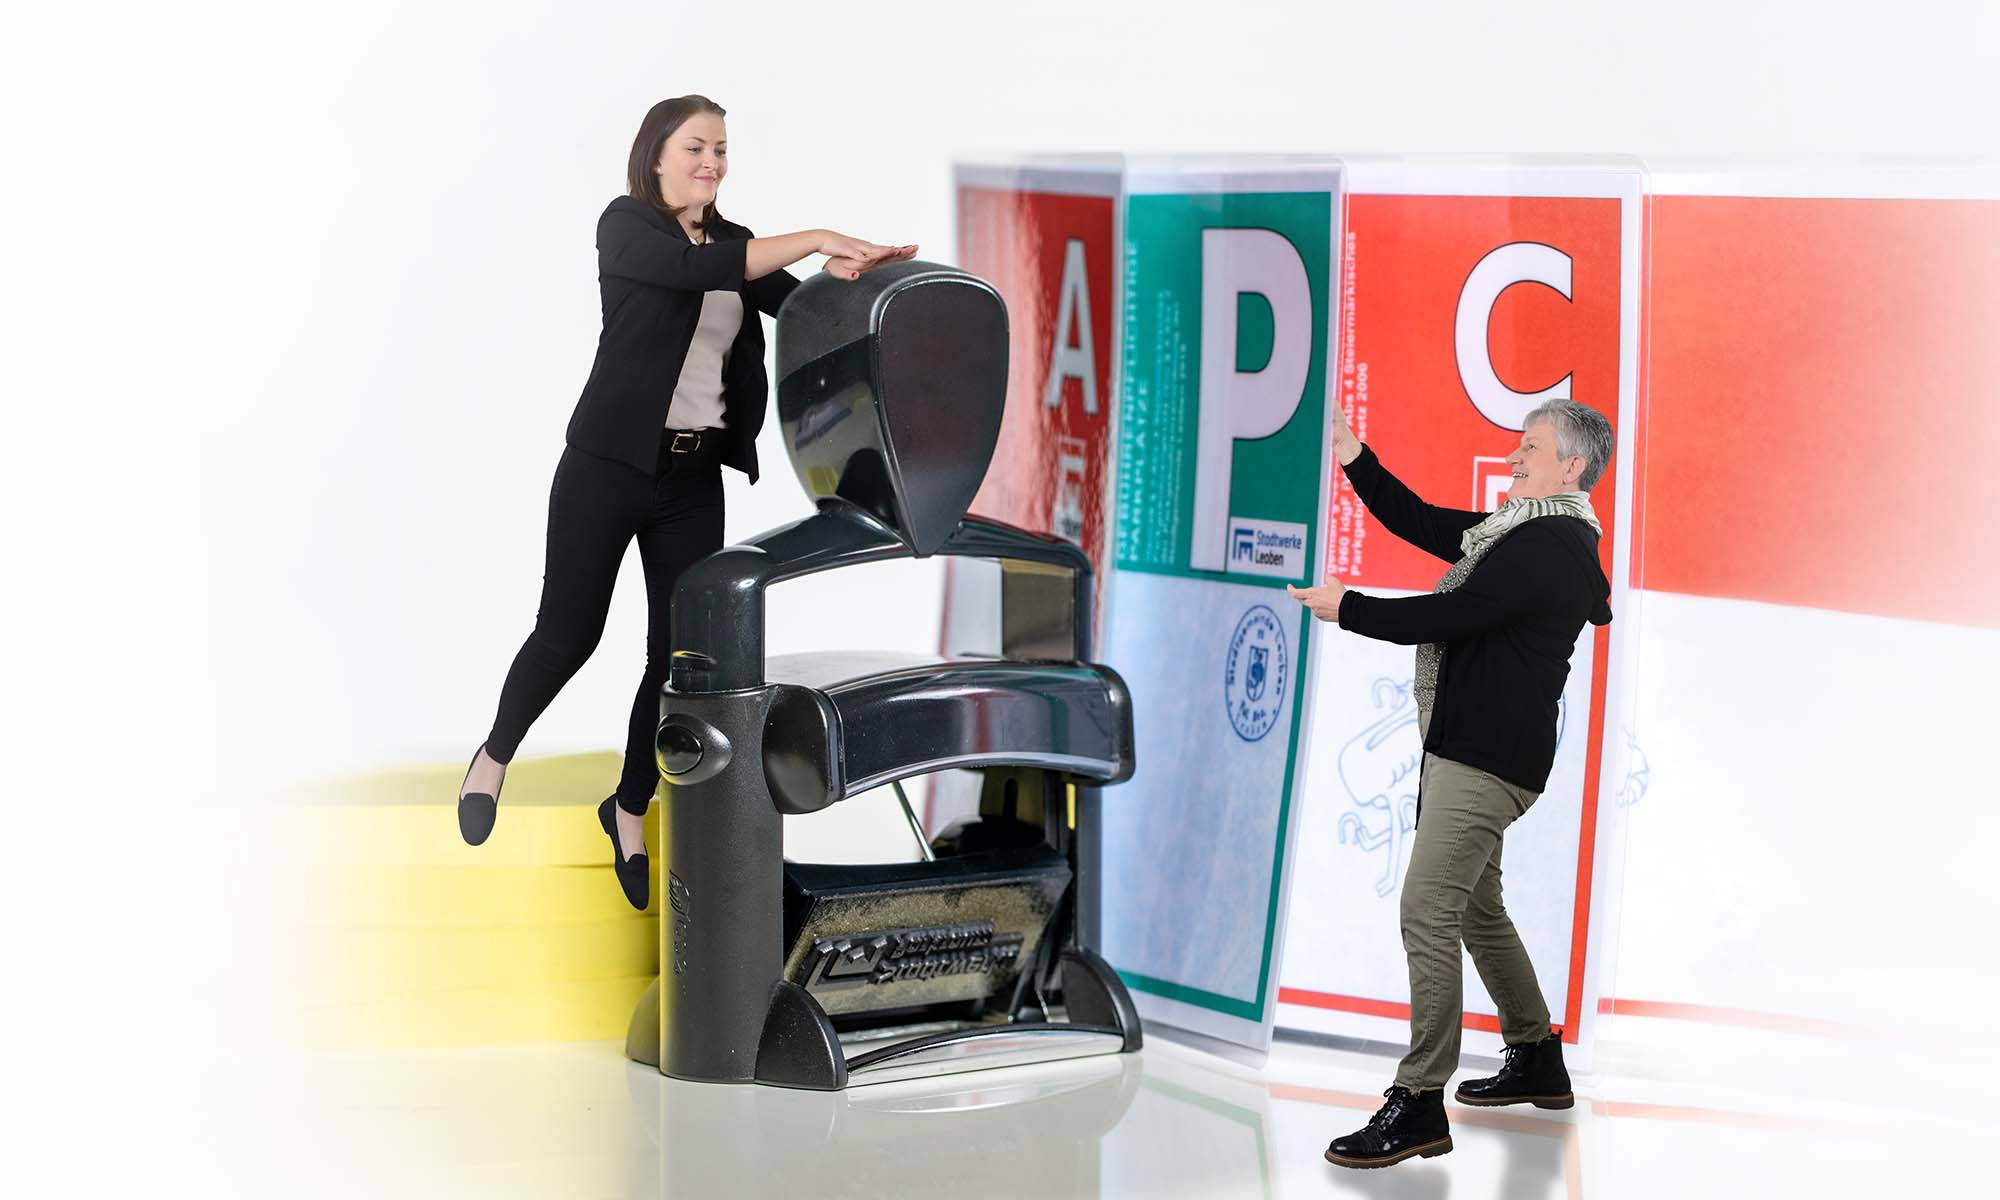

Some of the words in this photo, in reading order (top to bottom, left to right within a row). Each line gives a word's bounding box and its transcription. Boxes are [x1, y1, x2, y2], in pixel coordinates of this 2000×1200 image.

[1045, 237, 1099, 416] A
[1454, 241, 1573, 432] C
[1190, 227, 1313, 574] P
[1343, 379, 1355, 389] 4
[1356, 362, 1368, 402] 2006
[1254, 549, 1285, 567] Leoben
[1256, 530, 1303, 550] Stadtwerke
[1338, 536, 1350, 574] 1960
